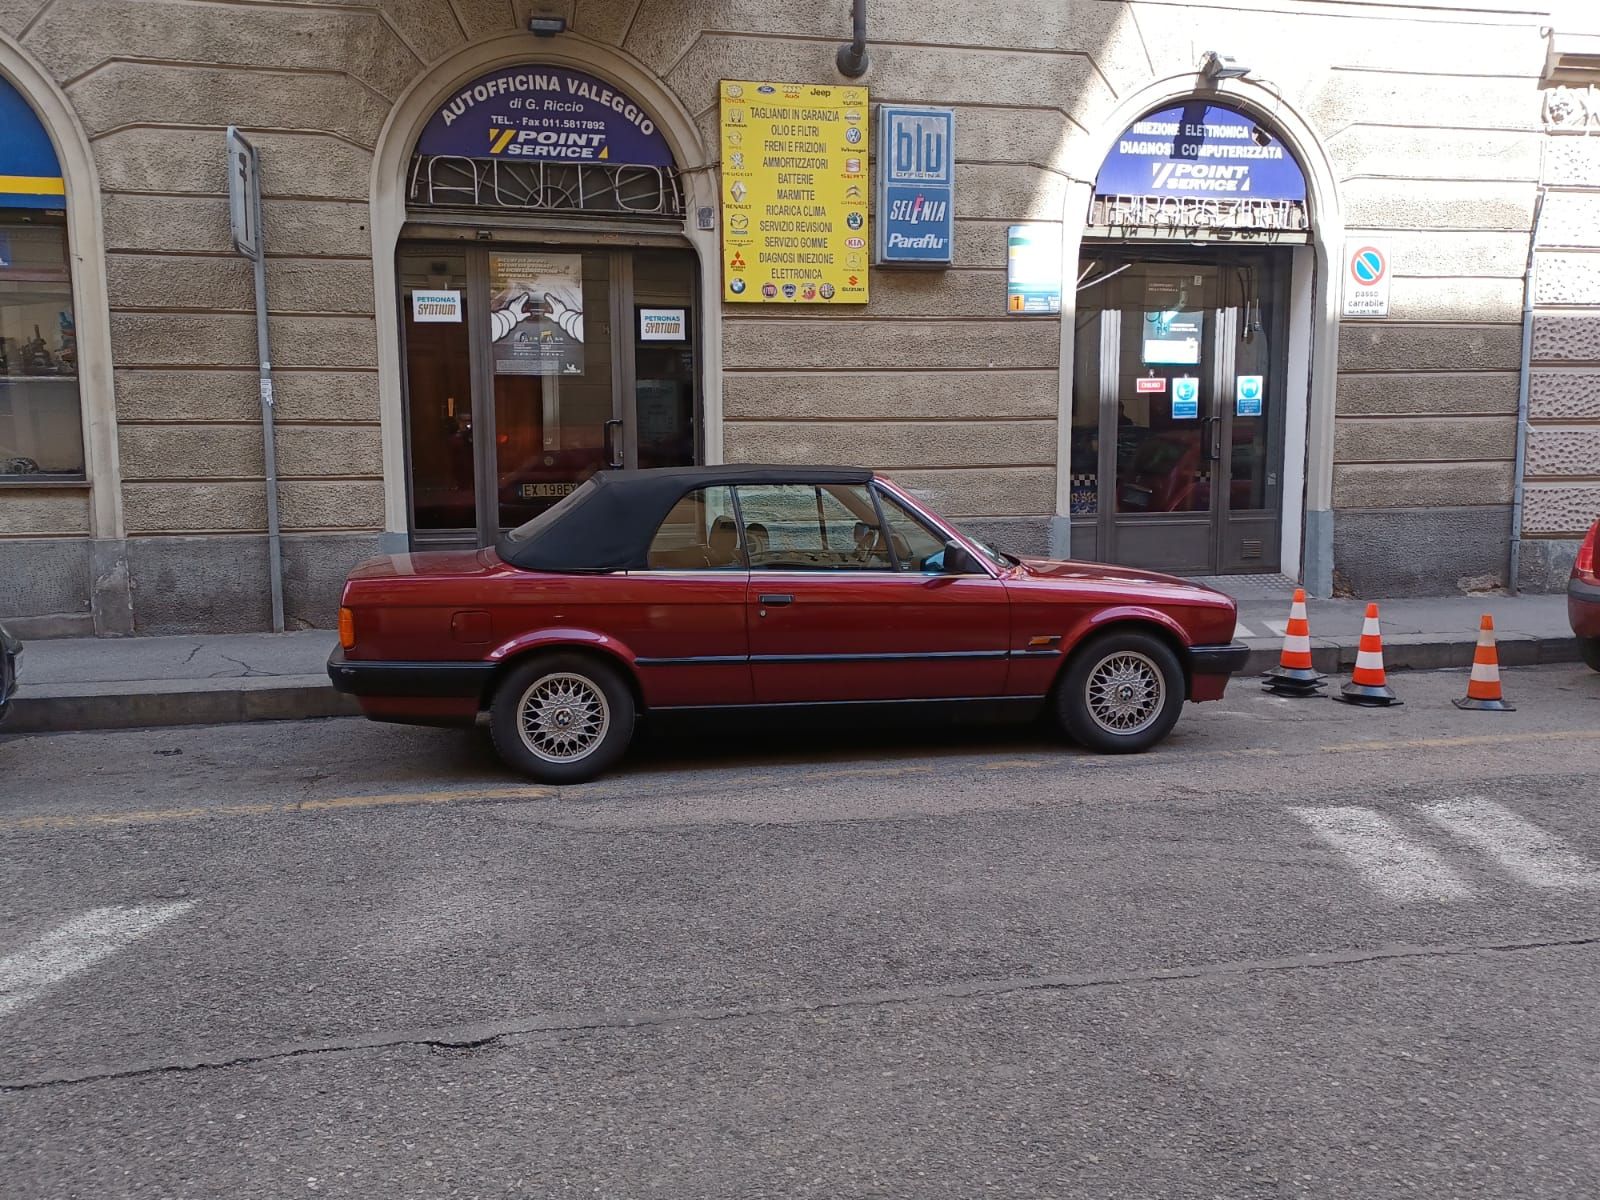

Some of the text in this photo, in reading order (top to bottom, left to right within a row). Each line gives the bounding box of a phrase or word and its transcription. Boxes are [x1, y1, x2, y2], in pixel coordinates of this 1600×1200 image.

[810, 88, 831, 98] Jeep
[441, 75, 655, 136] AUTOFFICINA VALEGGIO
[509, 98, 584, 112] di G. Riccio
[750, 107, 791, 120] TAGLIANDI
[792, 109, 800, 120] IN
[801, 110, 840, 122] GARANZIA
[491, 115, 513, 125] TEL.
[522, 117, 540, 126] Fax
[542, 118, 605, 130] 011.5817892
[771, 124, 819, 137] OLIO E FILTRI
[1133, 121, 1249, 138] INIEZIONE ELETTRONICA
[517, 130, 606, 146] POINT
[508, 143, 593, 158] SERVICE
[764, 140, 827, 153] FRENI E FRIZIONI
[896, 122, 942, 173] blu
[1120, 141, 1283, 159] DIAGNOSI COMPUTERIZZATA
[762, 156, 828, 169] AMMORTIZZATORI
[1175, 164, 1248, 179] POINT
[778, 173, 814, 185] BATTERIE
[1166, 178, 1239, 191] SERVICE
[776, 189, 815, 200] MARMITTE
[766, 204, 827, 217] RICARICA CLIMA
[889, 194, 947, 225] SELENIA
[760, 220, 833, 233] SERVIZIO REVISIONI
[765, 236, 828, 249] SERVIZIO GOMME
[848, 239, 863, 247] KIA
[759, 252, 834, 264] DIAGNOSI INIEZIONE
[771, 268, 823, 279] ELETTRONICA
[417, 303, 456, 315] SYNTIUM
[1348, 299, 1384, 307] carrabile
[644, 322, 681, 334] SYNTIUM
[524, 485, 538, 496] EX
